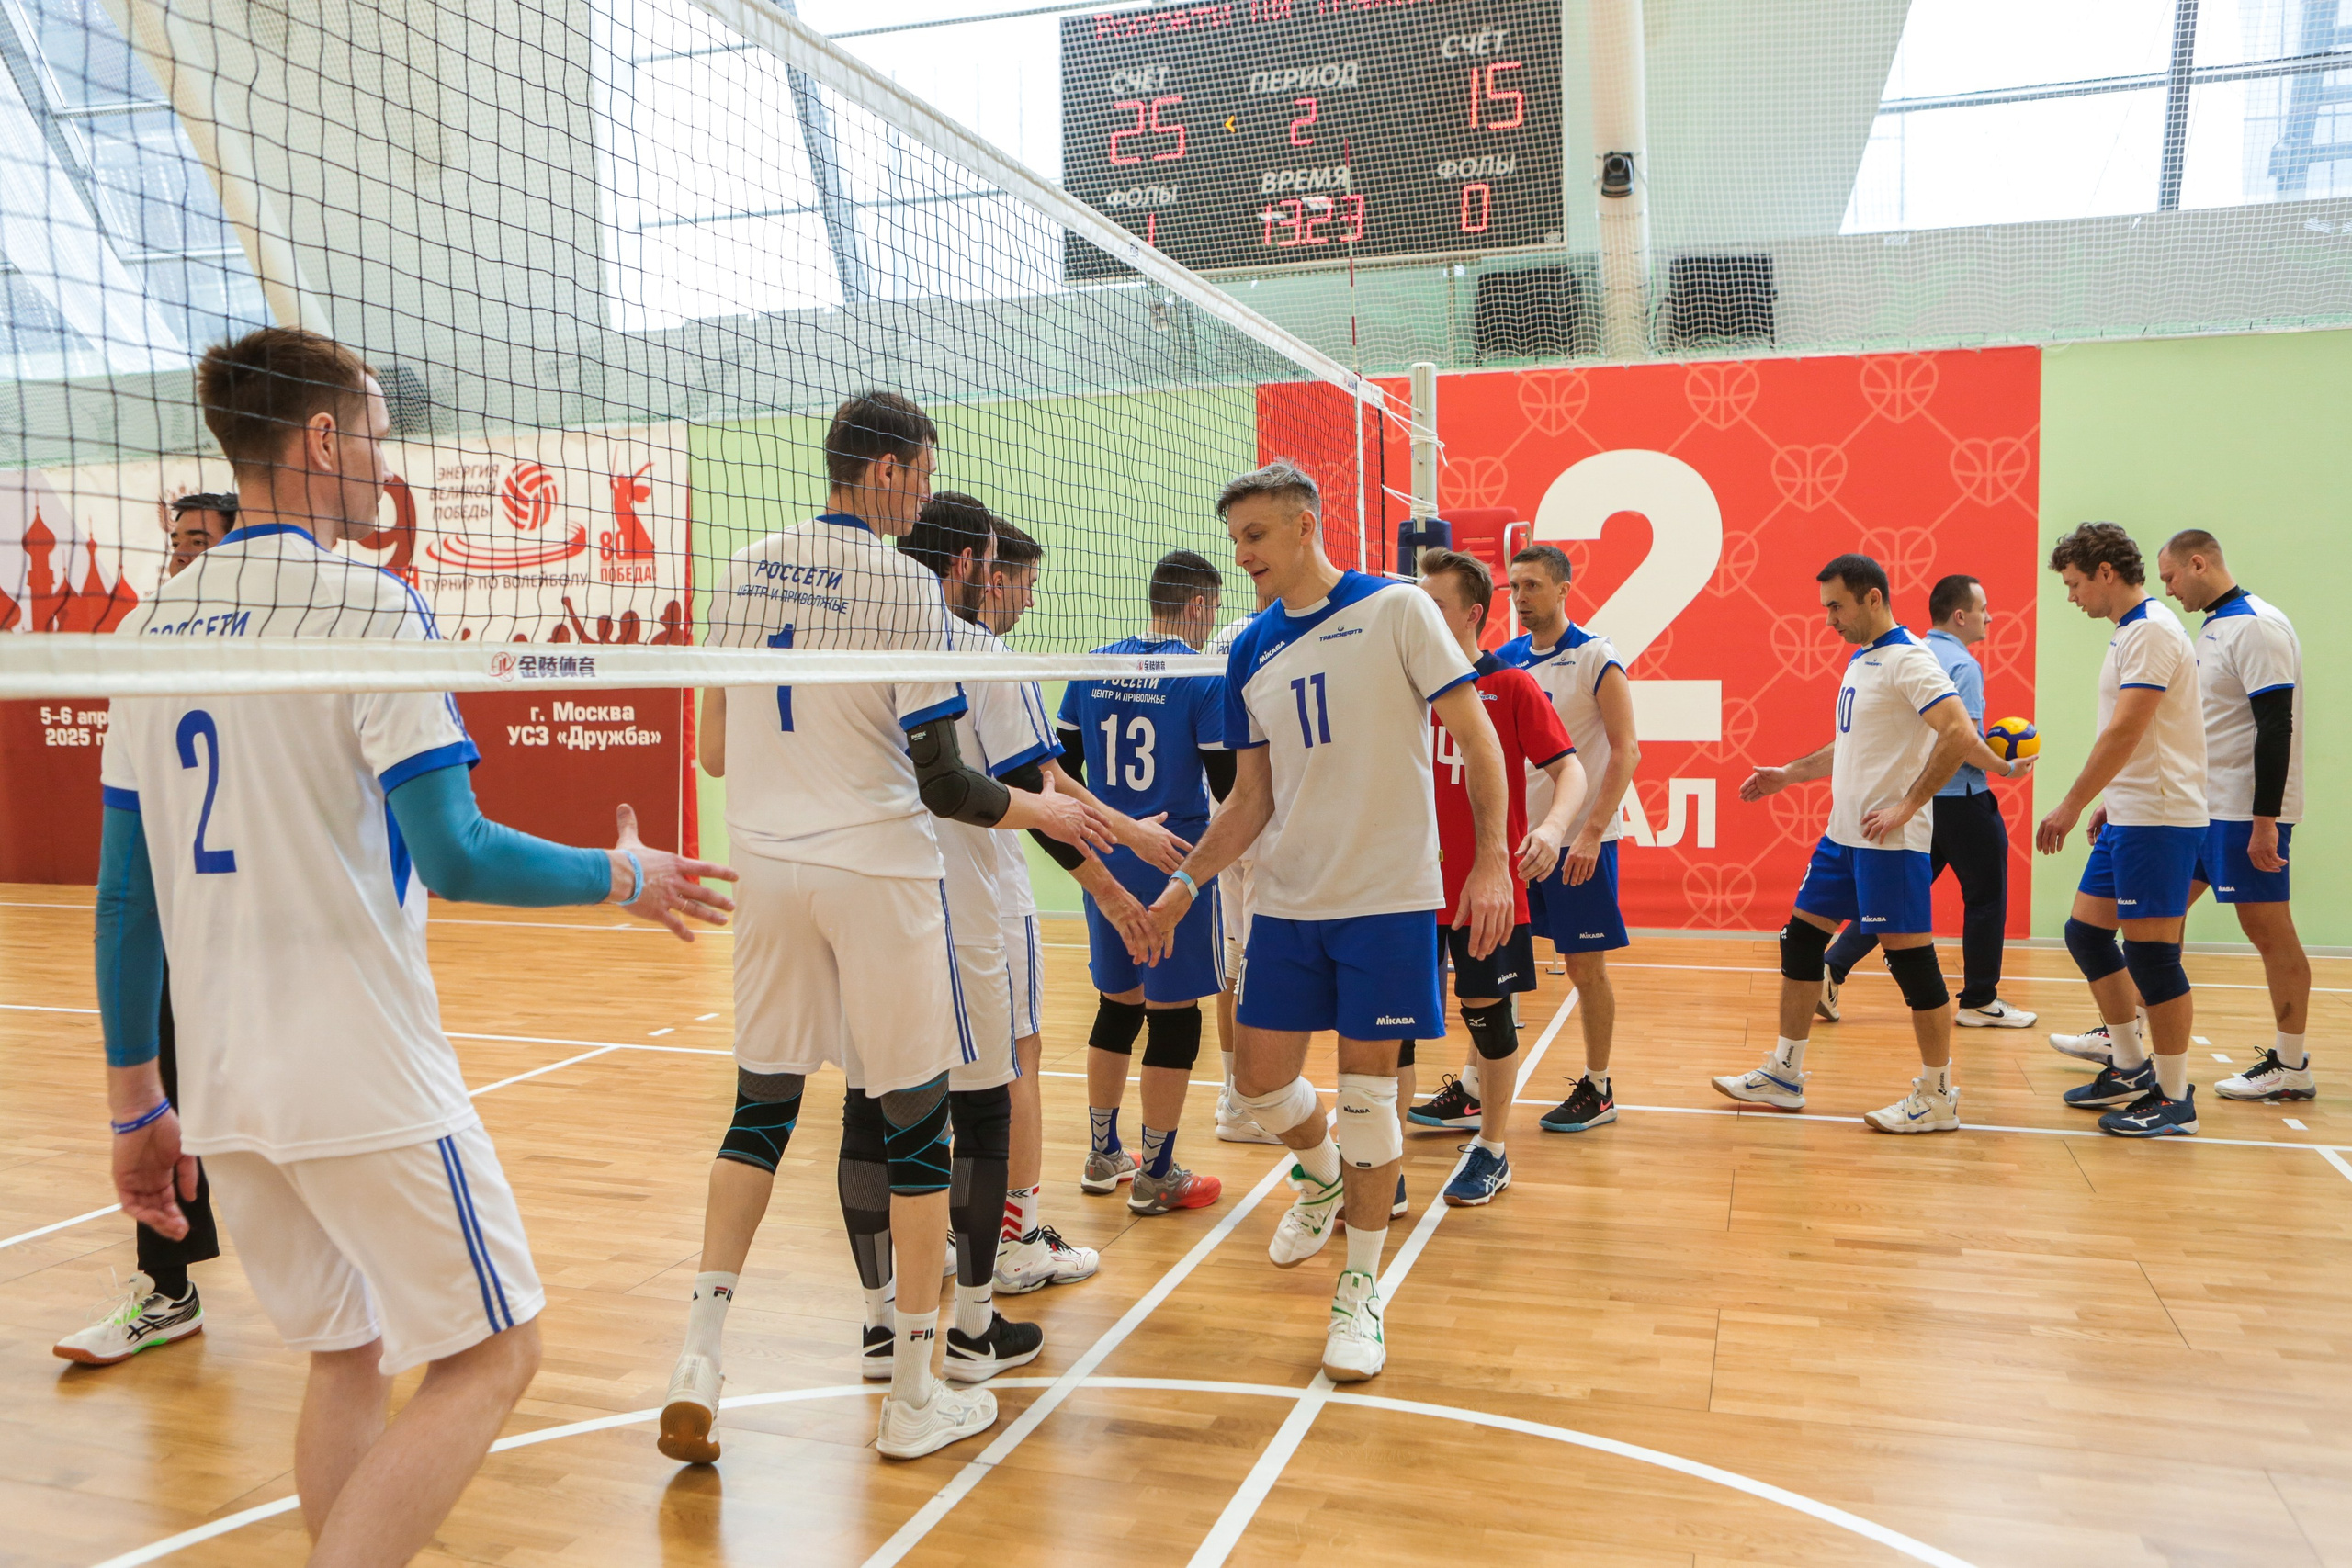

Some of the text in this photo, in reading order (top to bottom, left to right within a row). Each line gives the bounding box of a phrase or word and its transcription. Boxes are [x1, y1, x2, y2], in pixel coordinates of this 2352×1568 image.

[1250, 61, 1359, 93] ПЕРИОД
[1470, 61, 1523, 129] 15
[1110, 96, 1185, 164] 25
[1290, 97, 1317, 145] 2
[1261, 165, 1350, 194] ВРЕМЯ
[1437, 153, 1516, 179] ФОЛЫ
[1106, 184, 1179, 208] ФОЛЫ
[1462, 183, 1490, 231] 0
[436, 464, 500, 481] ЭНЕРГИЯ
[429, 482, 497, 502] ВЕЛИКОЙ
[432, 505, 493, 522] ПОБЕДЫ
[599, 530, 625, 562] 80
[424, 577, 476, 592] ТУРНИР
[481, 575, 501, 590] ПО
[503, 570, 589, 590] ВОЛЕЙБОЛУ
[600, 565, 657, 584] ПОБЕДА!
[755, 559, 843, 590] РОССЕТИ
[737, 584, 850, 615] ЦЕНТР И ПРИВОЛЖЬЕ
[1533, 448, 1723, 742] 2
[1319, 628, 1363, 642] ТРАНСНЕФТЬ
[1091, 688, 1167, 705] ЦЕНТР И ПРИВОЛЖЬЕ
[1290, 672, 1331, 749] 11
[1838, 686, 1856, 733] 10
[77, 710, 109, 729] апр
[530, 701, 636, 722] г. Москва
[46, 728, 90, 746] 2025
[507, 725, 662, 750] УСЗ «Дружба»
[1101, 713, 1156, 792] 13
[175, 709, 237, 874] 2
[1619, 778, 1718, 849] АЛ
[910, 1327, 936, 1342] FIL
